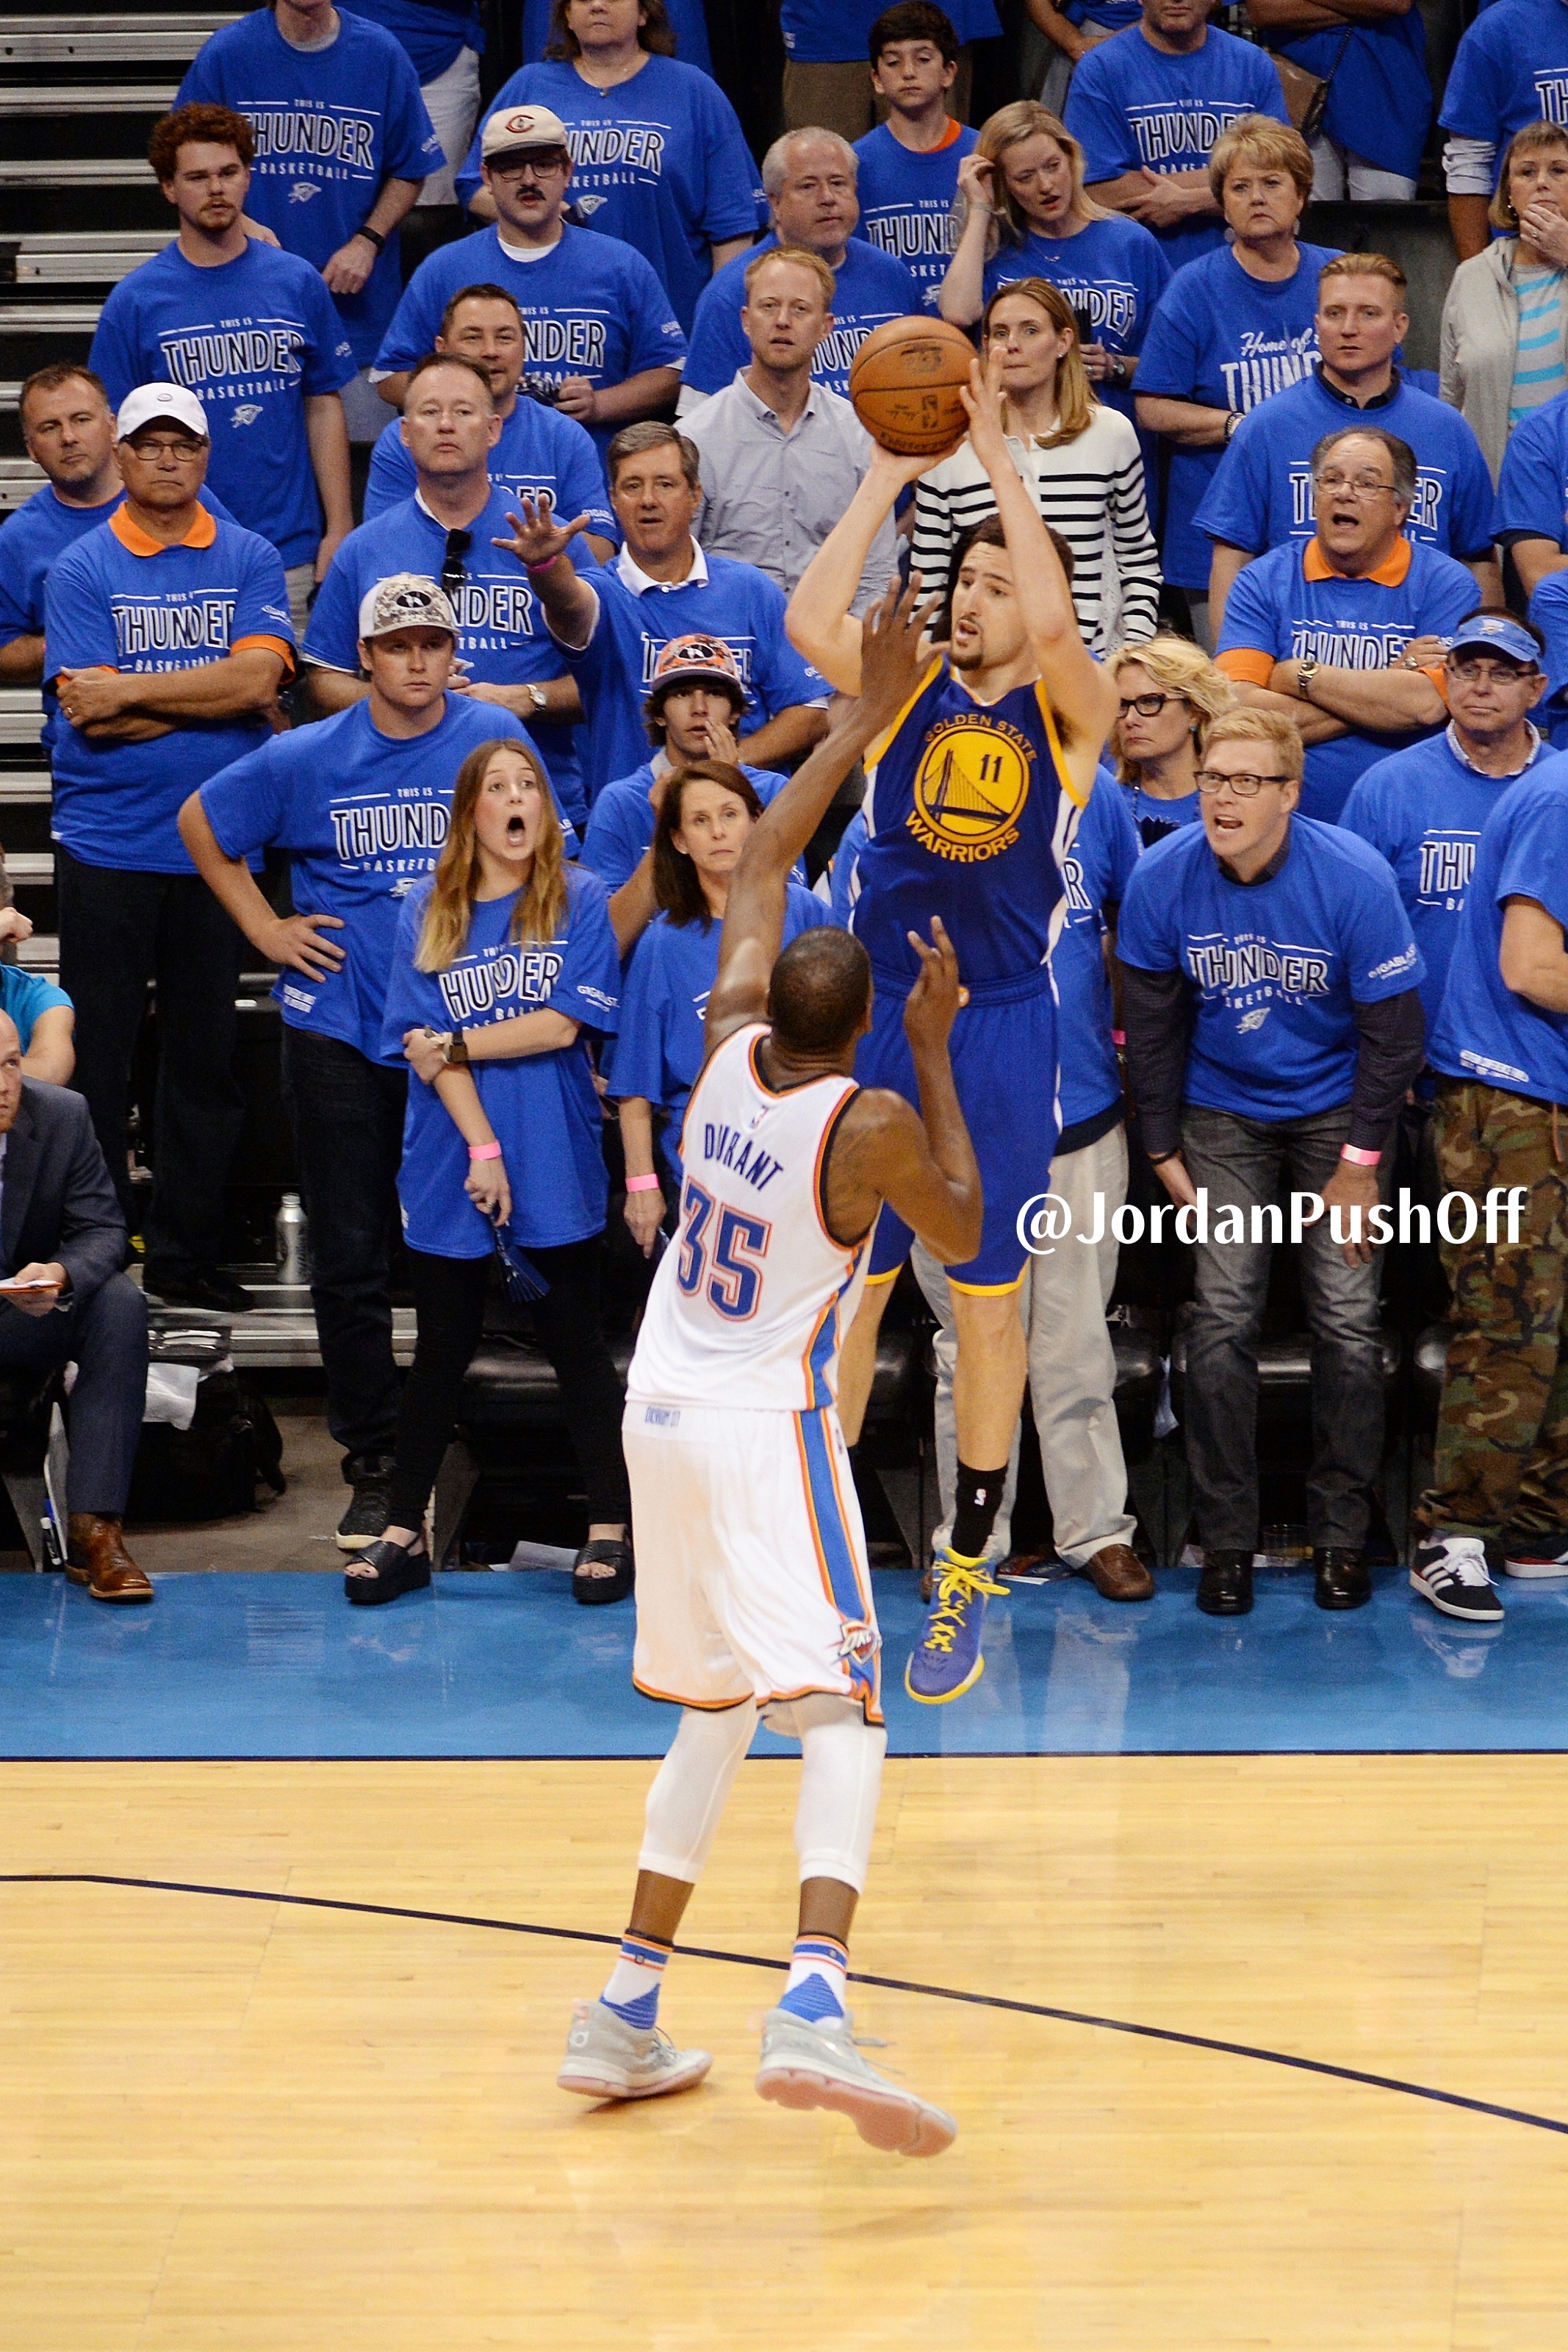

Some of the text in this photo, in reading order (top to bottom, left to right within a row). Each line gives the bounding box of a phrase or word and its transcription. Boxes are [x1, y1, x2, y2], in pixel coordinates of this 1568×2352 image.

[295, 99, 324, 109] THIS IS
[260, 162, 348, 179] BASKETBALL
[220, 317, 252, 328] THIS IS
[1240, 331, 1287, 357] Home
[1291, 327, 1313, 355] of
[522, 319, 606, 368] NDER
[924, 714, 1037, 763] GOLDEN STATE
[979, 753, 1003, 783] 11
[397, 787, 433, 797] THIS IS
[331, 803, 452, 861] THUND
[905, 809, 1021, 863] WARRIORS
[363, 858, 436, 872] BASKETB
[439, 952, 564, 1022] HUNDER
[704, 1124, 783, 1191] DURANT
[677, 1175, 772, 1322] 35
